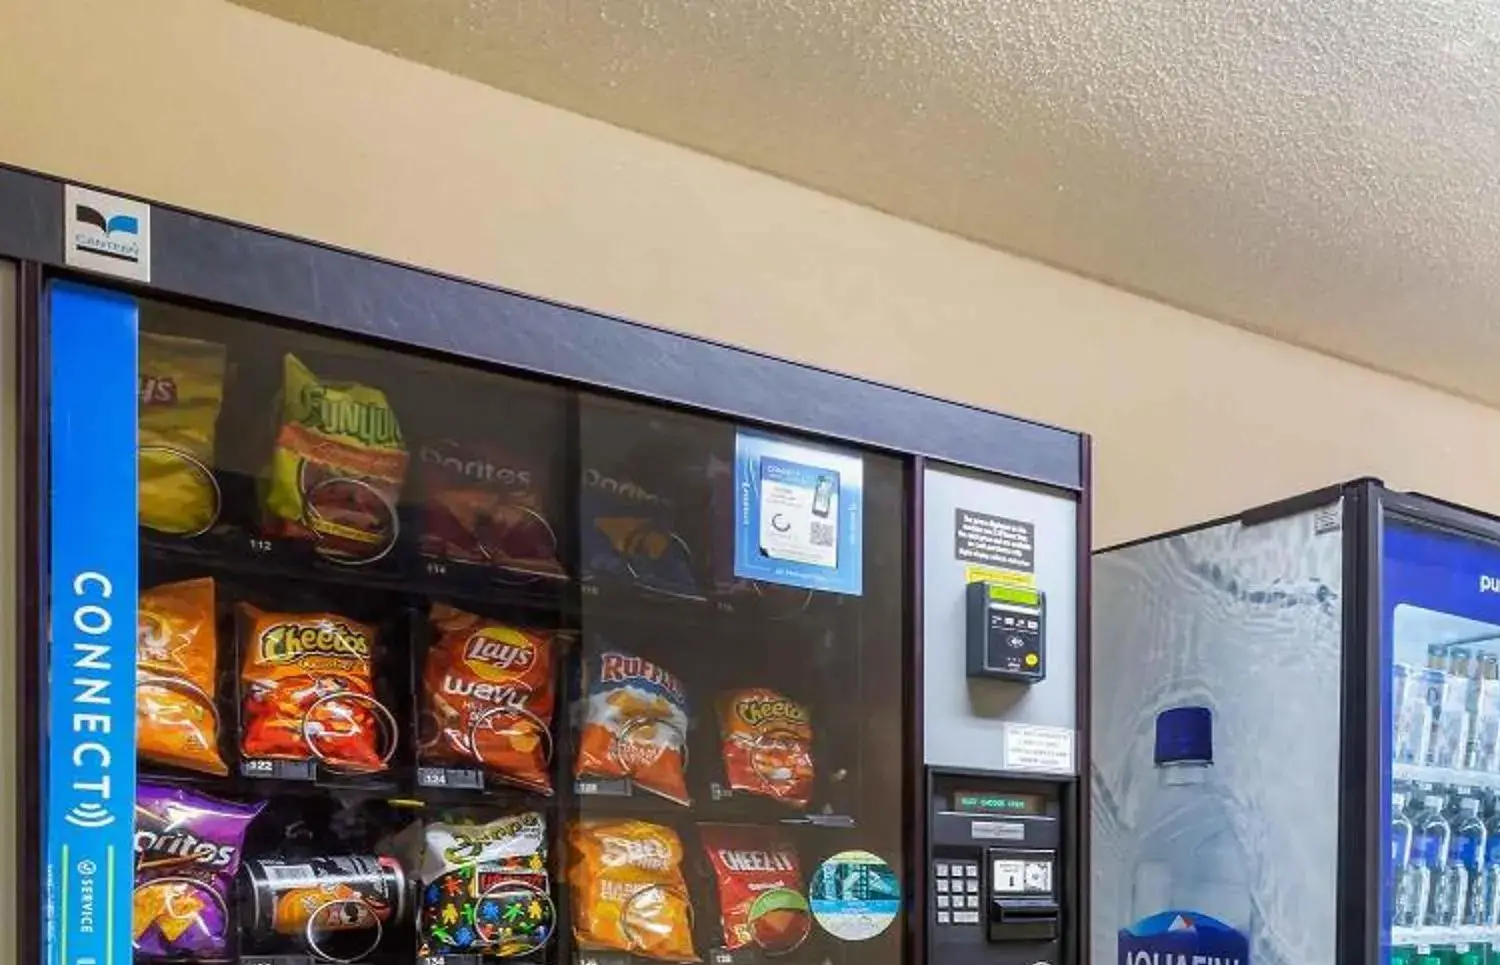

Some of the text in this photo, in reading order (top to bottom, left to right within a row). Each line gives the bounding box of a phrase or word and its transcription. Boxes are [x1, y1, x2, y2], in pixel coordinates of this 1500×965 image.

[262, 623, 369, 661] Cheetos
[470, 636, 532, 669] Lay's
[72, 571, 113, 799] CONNECT
[134, 830, 236, 866] oritos
[80, 879, 95, 934] SERVICE
